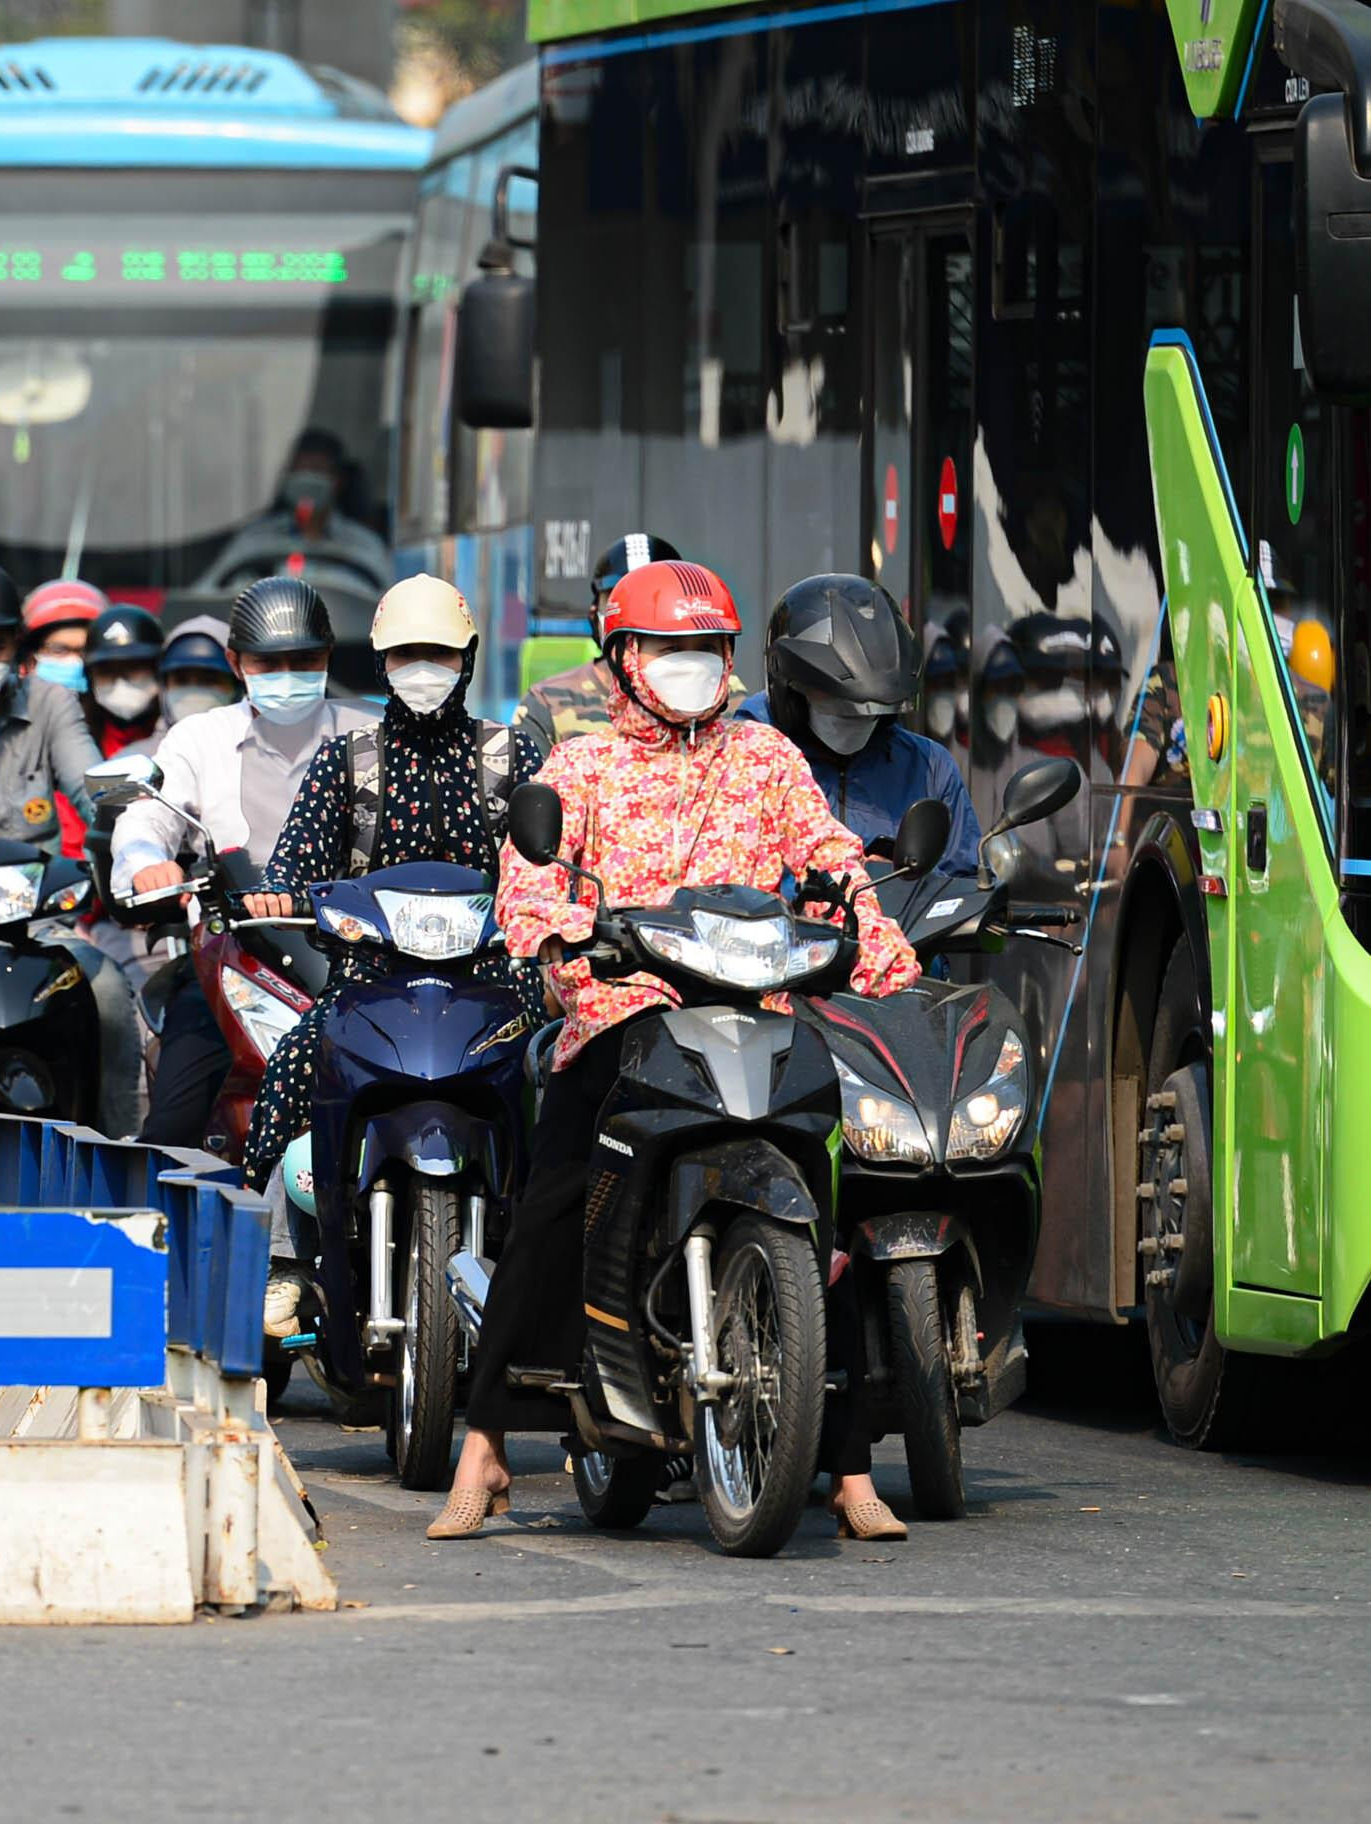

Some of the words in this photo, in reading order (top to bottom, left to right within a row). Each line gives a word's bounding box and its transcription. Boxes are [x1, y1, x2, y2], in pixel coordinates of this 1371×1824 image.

[406, 977, 454, 989] HONDA
[711, 1013, 757, 1025] HONDA
[598, 1132, 634, 1157] HONDA
